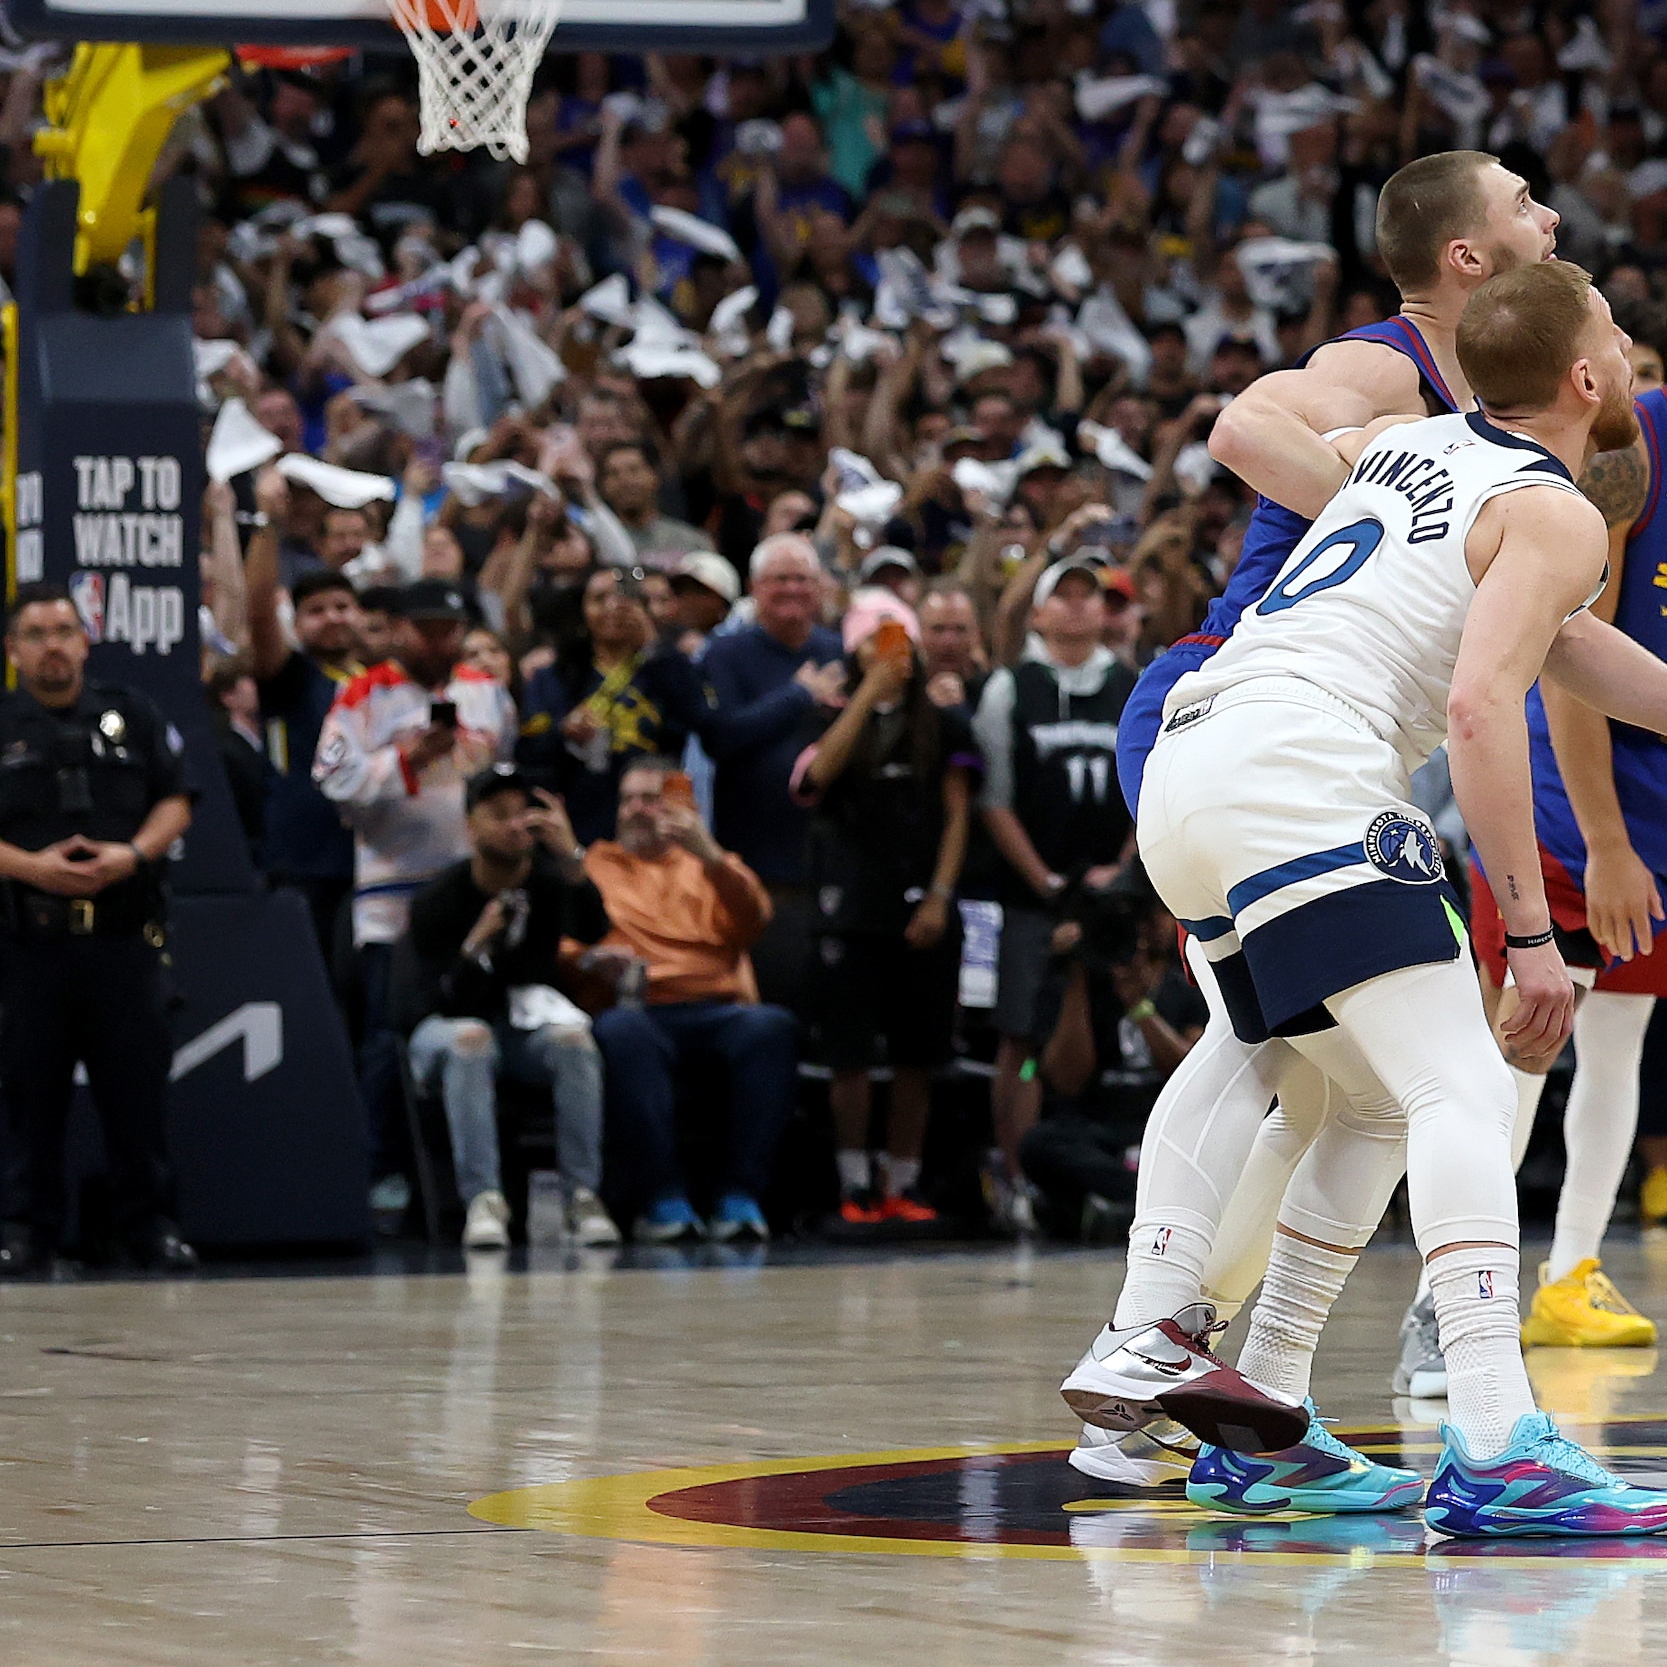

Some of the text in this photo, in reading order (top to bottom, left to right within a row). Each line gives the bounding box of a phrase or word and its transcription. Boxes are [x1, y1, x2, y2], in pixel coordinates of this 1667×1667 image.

[73, 455, 183, 511] TAP TO
[72, 512, 184, 567] WATCH
[1256, 517, 1385, 616] 0
[105, 571, 185, 656] App
[1366, 813, 1395, 863] MINNESOTA
